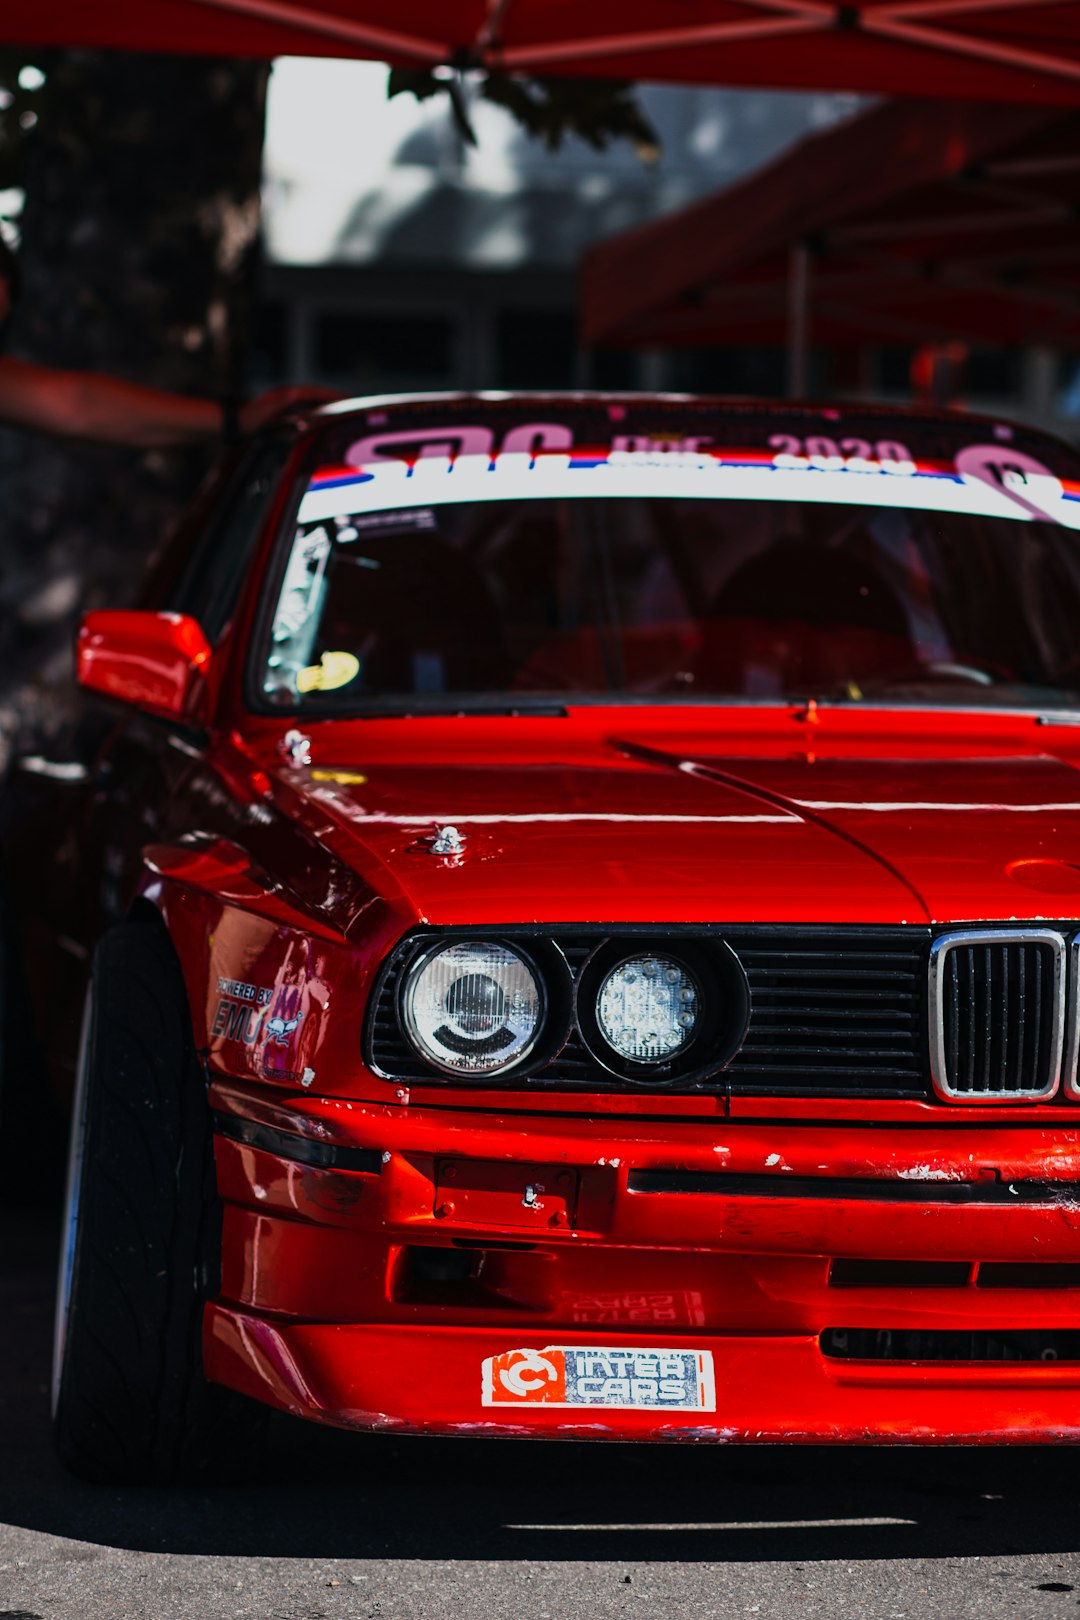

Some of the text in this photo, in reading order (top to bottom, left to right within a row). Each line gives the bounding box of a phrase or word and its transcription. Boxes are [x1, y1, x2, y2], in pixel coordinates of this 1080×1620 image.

[769, 433, 918, 476] 2020
[216, 976, 257, 1001] POWERED
[210, 999, 261, 1045] EMU
[576, 1357, 685, 1378] INTER
[576, 1377, 687, 1400] CARS
